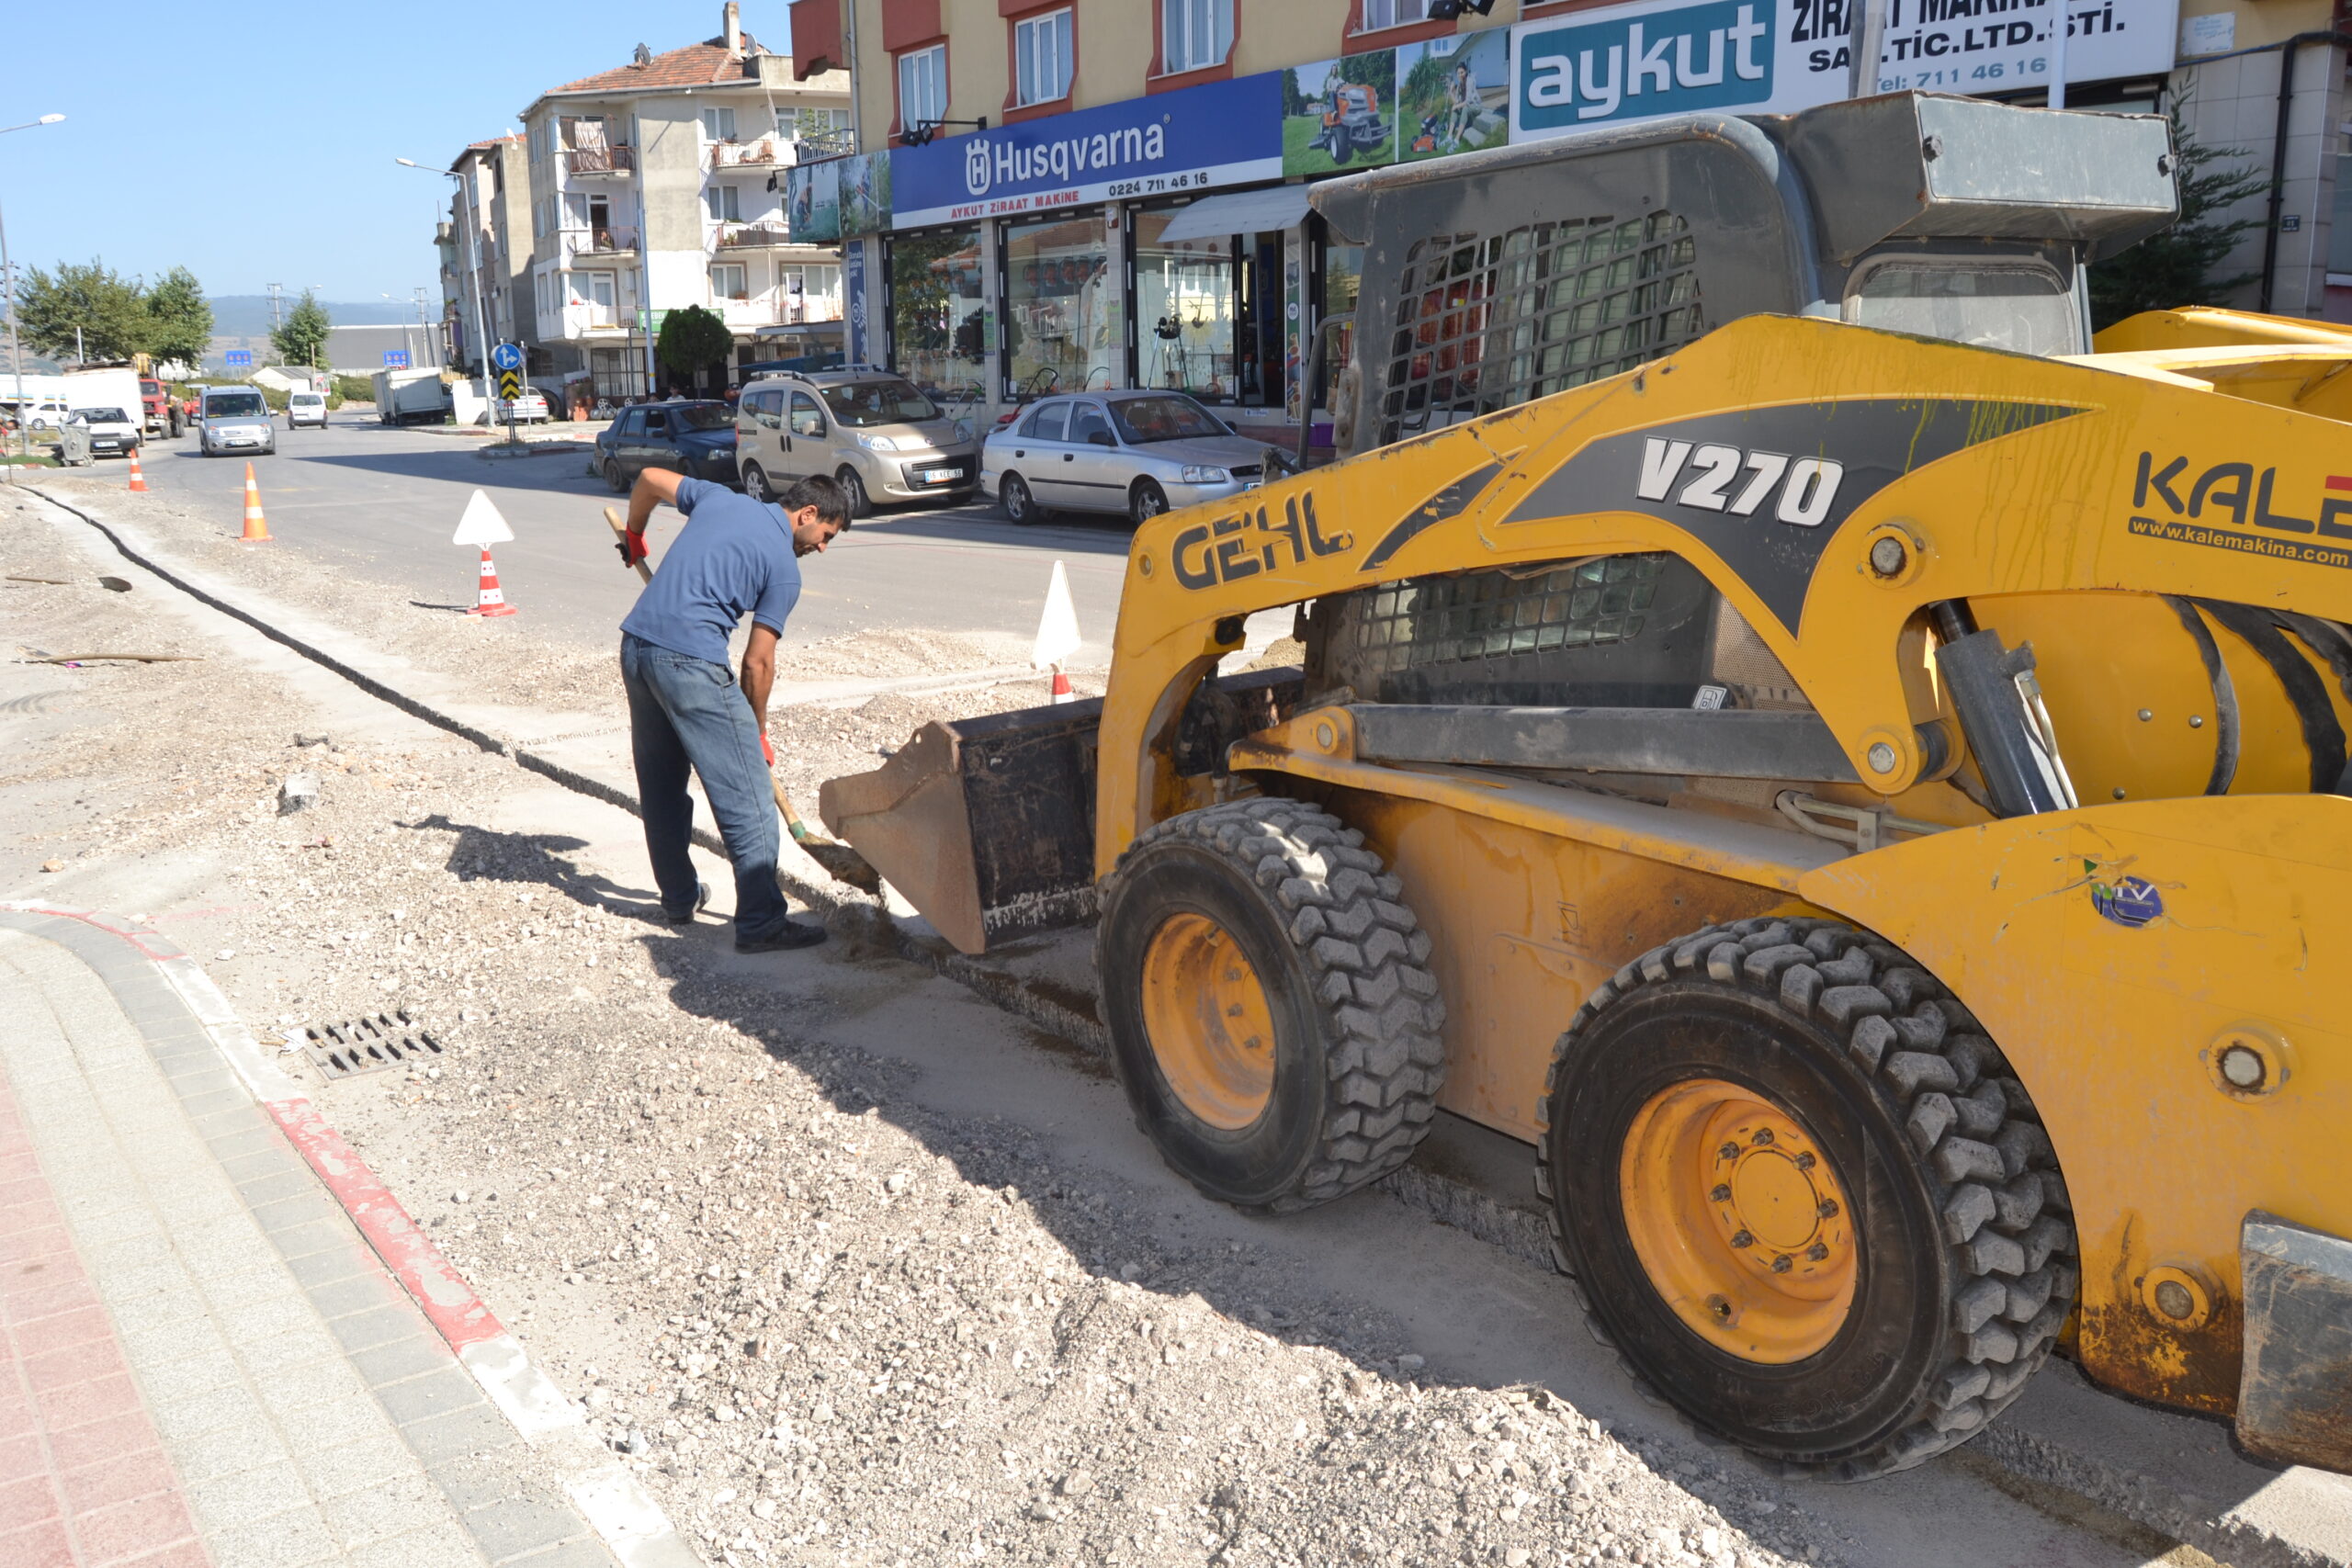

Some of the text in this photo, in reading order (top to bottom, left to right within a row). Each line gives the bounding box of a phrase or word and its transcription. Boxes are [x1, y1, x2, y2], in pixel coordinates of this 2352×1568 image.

[1528, 4, 1766, 119] aykut
[1878, 57, 2047, 92] el: 711 46 16
[995, 123, 1164, 184] Husqvarna
[951, 204, 985, 219] AYKUT
[1109, 172, 1208, 197] 0224 711 46 16
[1636, 435, 1845, 528] V270
[1171, 486, 1354, 592] GEHL
[2132, 519, 2350, 567] www.kalemakina.com
